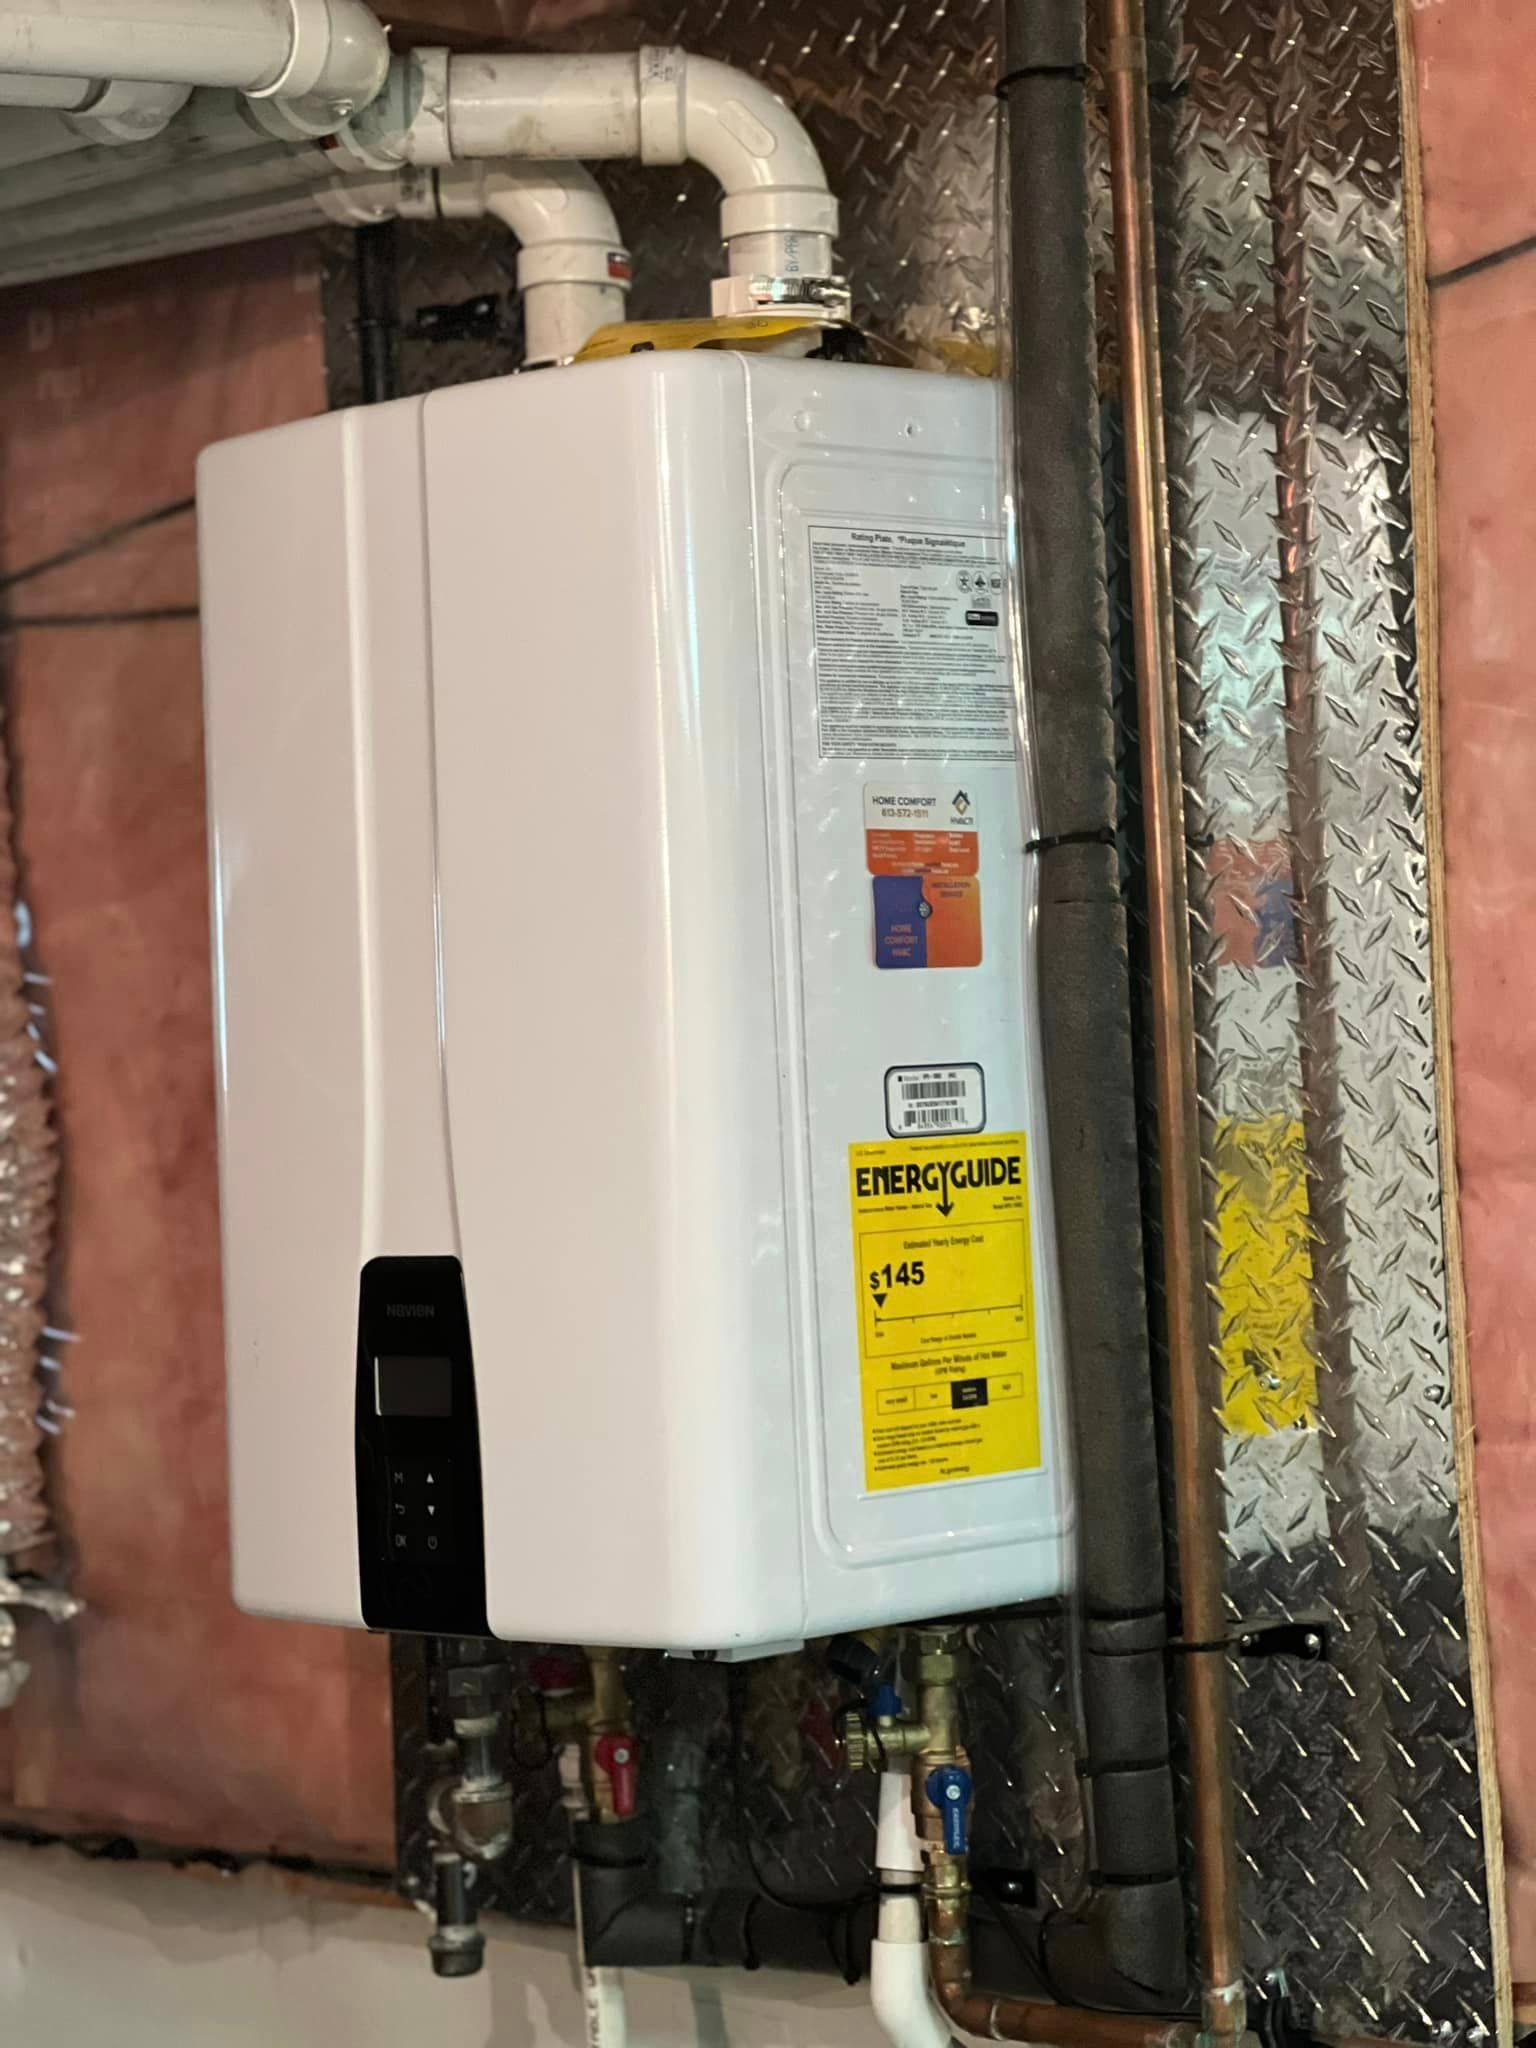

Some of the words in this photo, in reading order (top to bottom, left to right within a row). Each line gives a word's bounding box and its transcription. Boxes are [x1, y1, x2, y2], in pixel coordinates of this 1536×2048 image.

[851, 532, 874, 543] Rating
[872, 796, 896, 806] HOME
[897, 797, 936, 806] COMFORT
[869, 1261, 925, 1291] $145
[395, 1535, 407, 1547] OK
